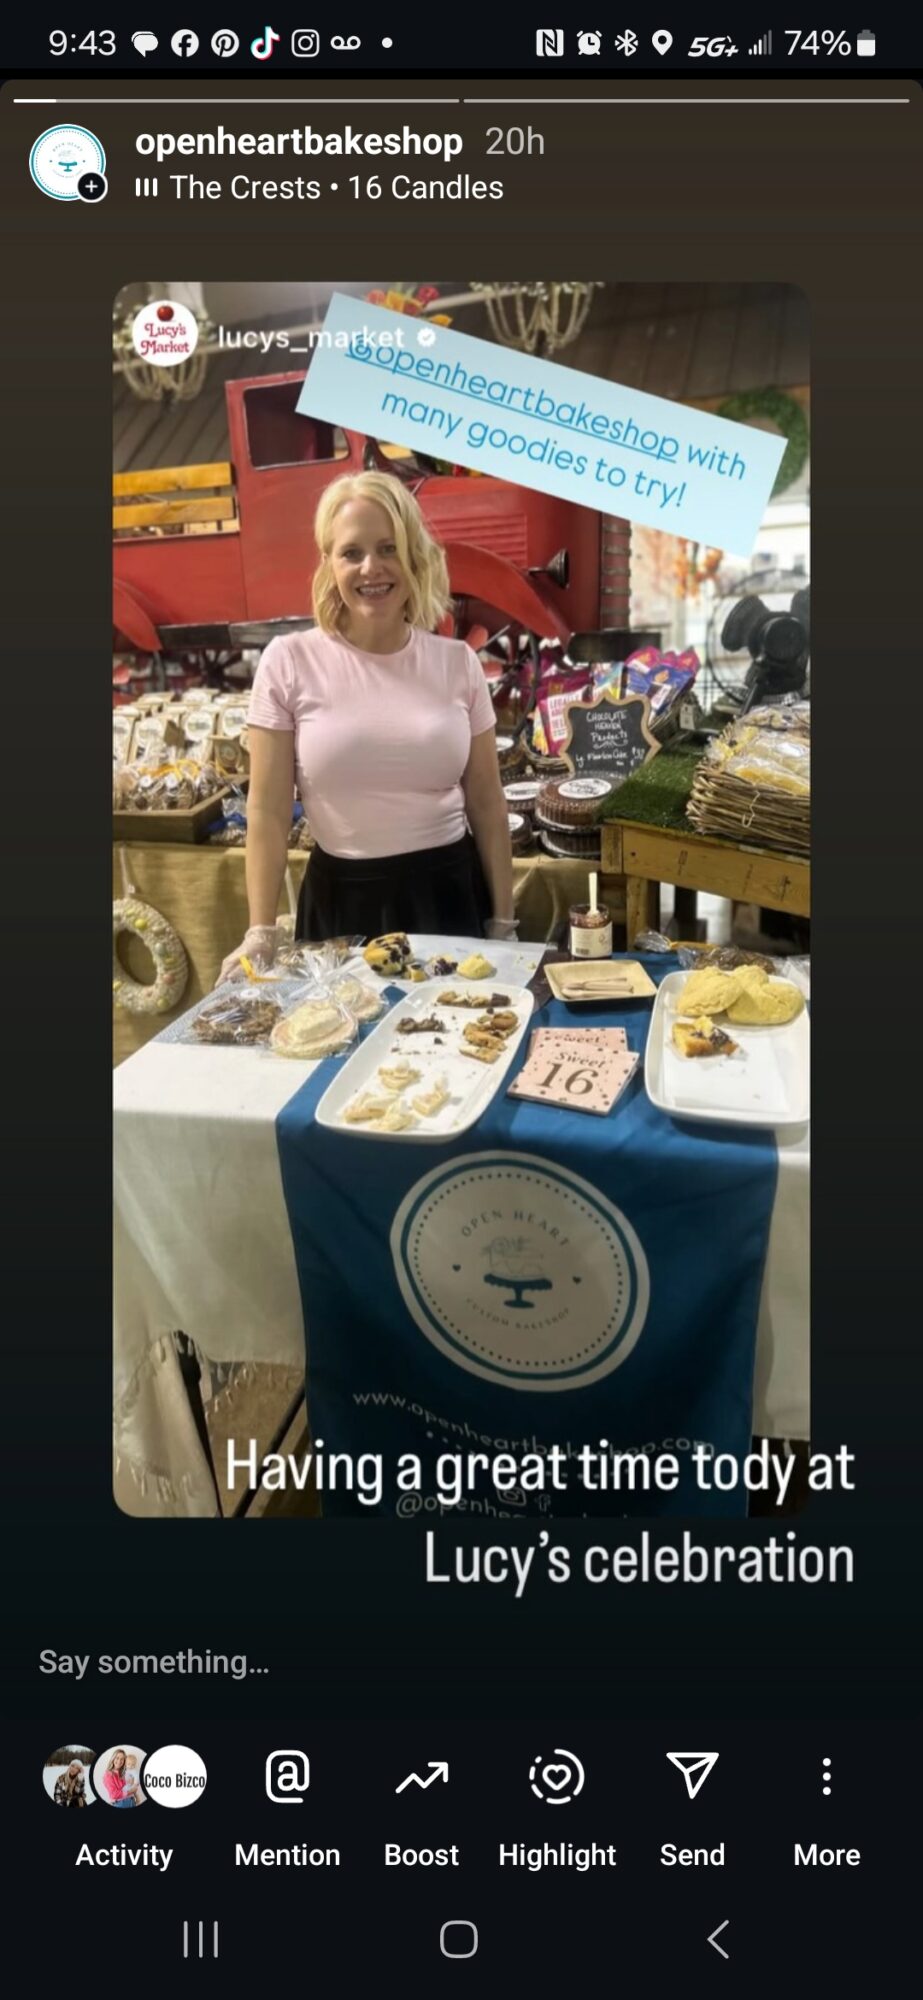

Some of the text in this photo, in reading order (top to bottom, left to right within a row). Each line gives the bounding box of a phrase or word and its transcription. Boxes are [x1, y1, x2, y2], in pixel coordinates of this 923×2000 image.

[555, 1051, 606, 1068] Sweet
[536, 1062, 598, 1095] 16
[462, 1210, 569, 1246] OPEN HEART
